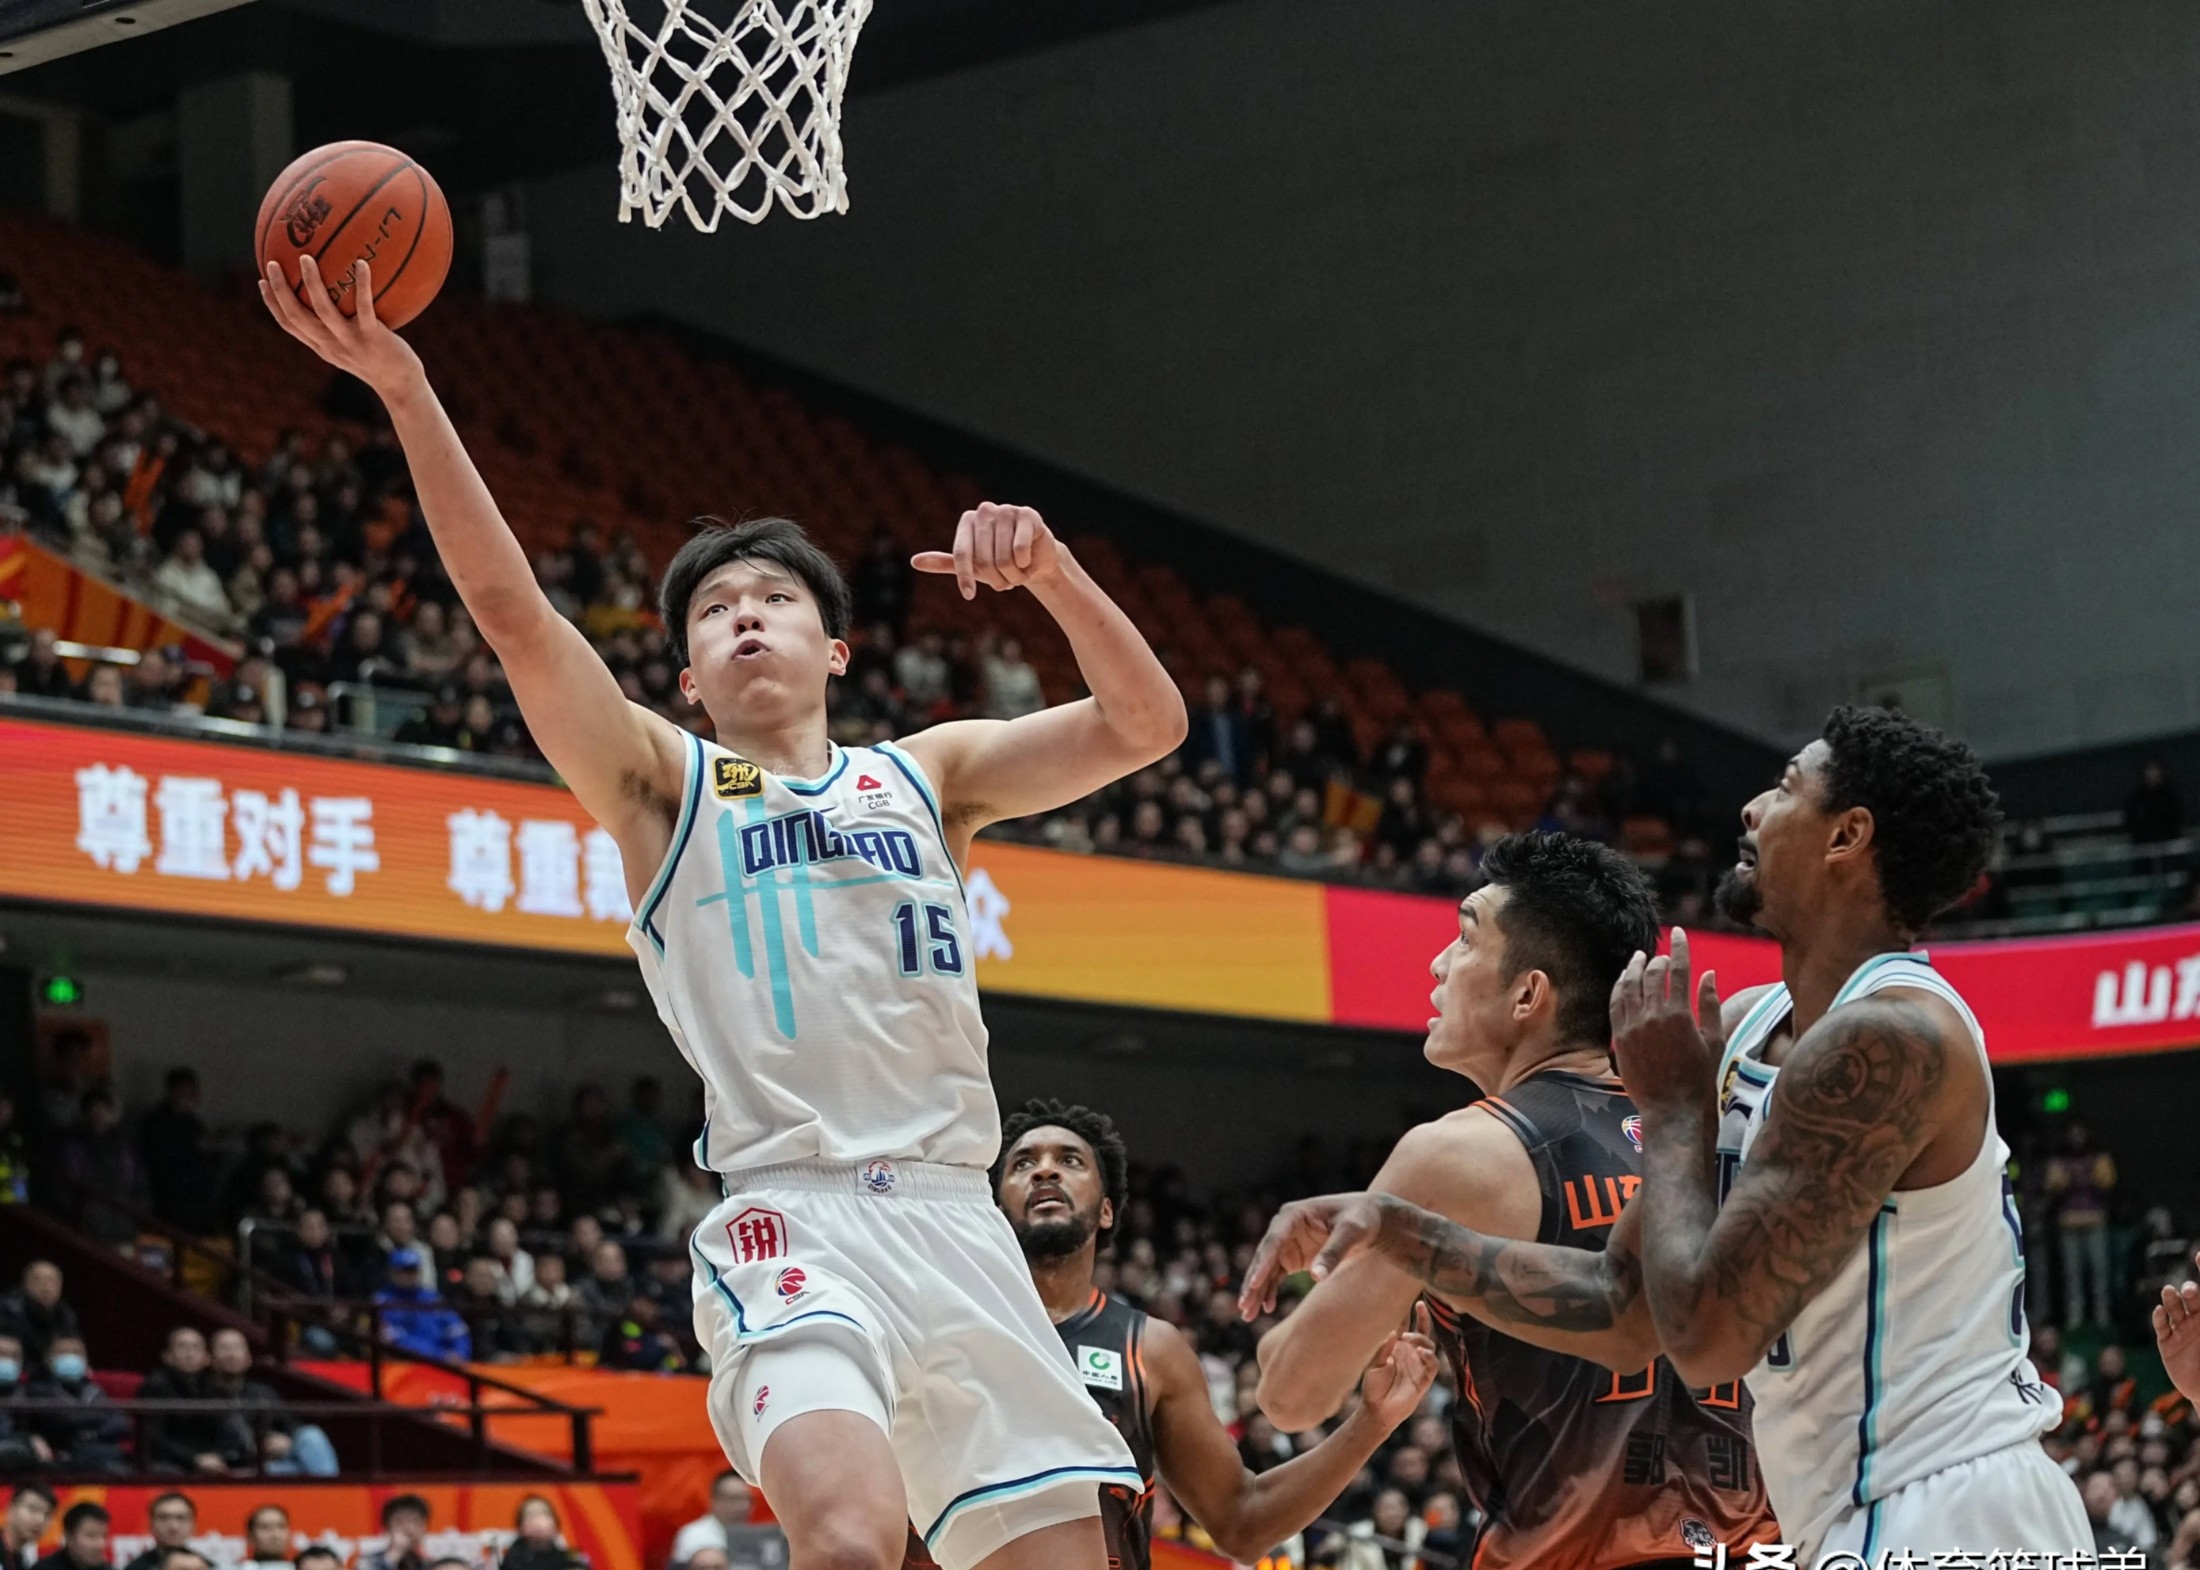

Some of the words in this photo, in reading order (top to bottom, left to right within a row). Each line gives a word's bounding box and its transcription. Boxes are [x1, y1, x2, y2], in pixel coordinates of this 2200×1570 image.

[328, 207, 402, 303] LI-NNG
[75, 762, 379, 895] 尊重对手
[868, 800, 890, 809] CGB
[891, 900, 964, 978] 15
